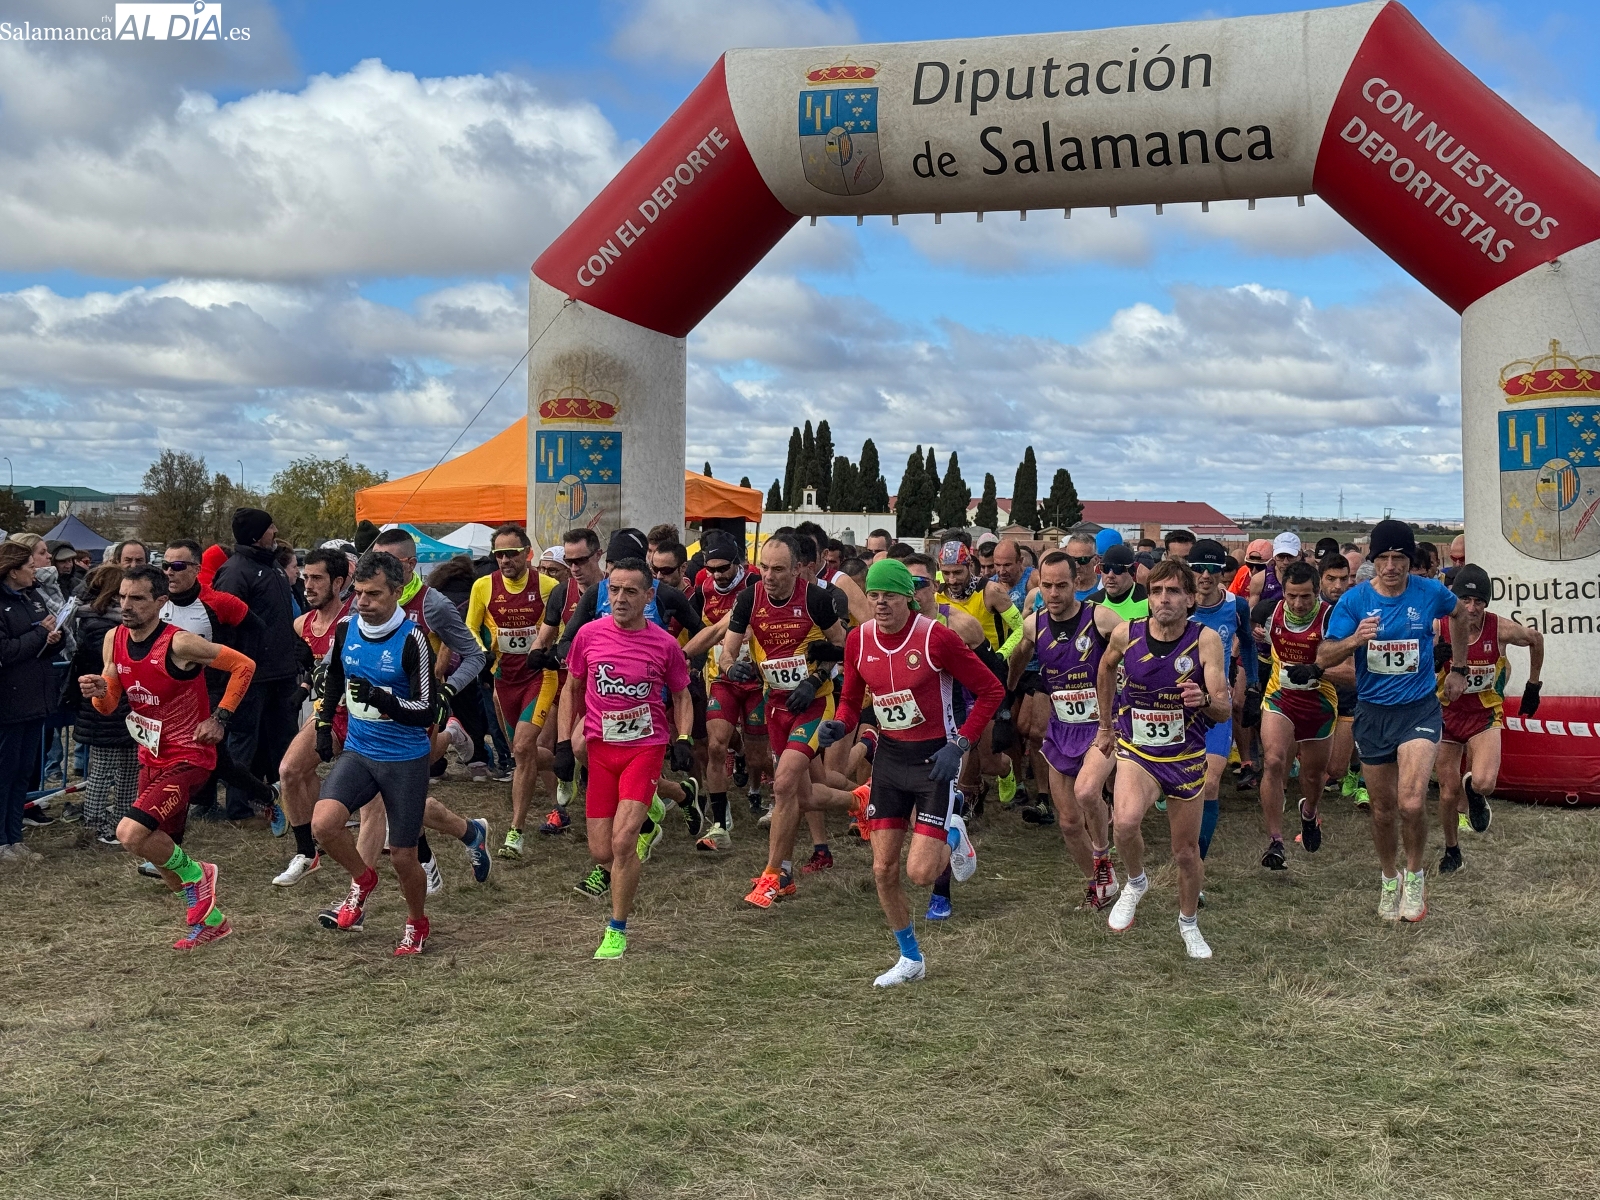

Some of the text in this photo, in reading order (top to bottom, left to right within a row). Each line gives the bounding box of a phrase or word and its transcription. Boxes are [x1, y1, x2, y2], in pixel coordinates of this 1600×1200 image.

[912, 44, 1212, 115] Diputación
[912, 121, 1275, 178] de Salamanca
[1362, 77, 1559, 240] CON NUESTROS
[1339, 115, 1515, 263] DEPORTISTAS
[577, 127, 730, 287] CON EL DEPORTE
[498, 629, 536, 637] bedunia
[509, 637, 527, 648] 63
[1369, 642, 1417, 651] bedunia
[762, 659, 805, 669] bedunia
[1383, 652, 1405, 666] 13
[771, 668, 801, 683] 186
[1068, 672, 1087, 680] PRIM
[1052, 691, 1096, 701] bedunia
[883, 706, 907, 722] 23
[1065, 701, 1085, 715] 30
[1133, 711, 1182, 721] bedunia
[617, 719, 640, 733] 24
[1146, 723, 1169, 738] 33
